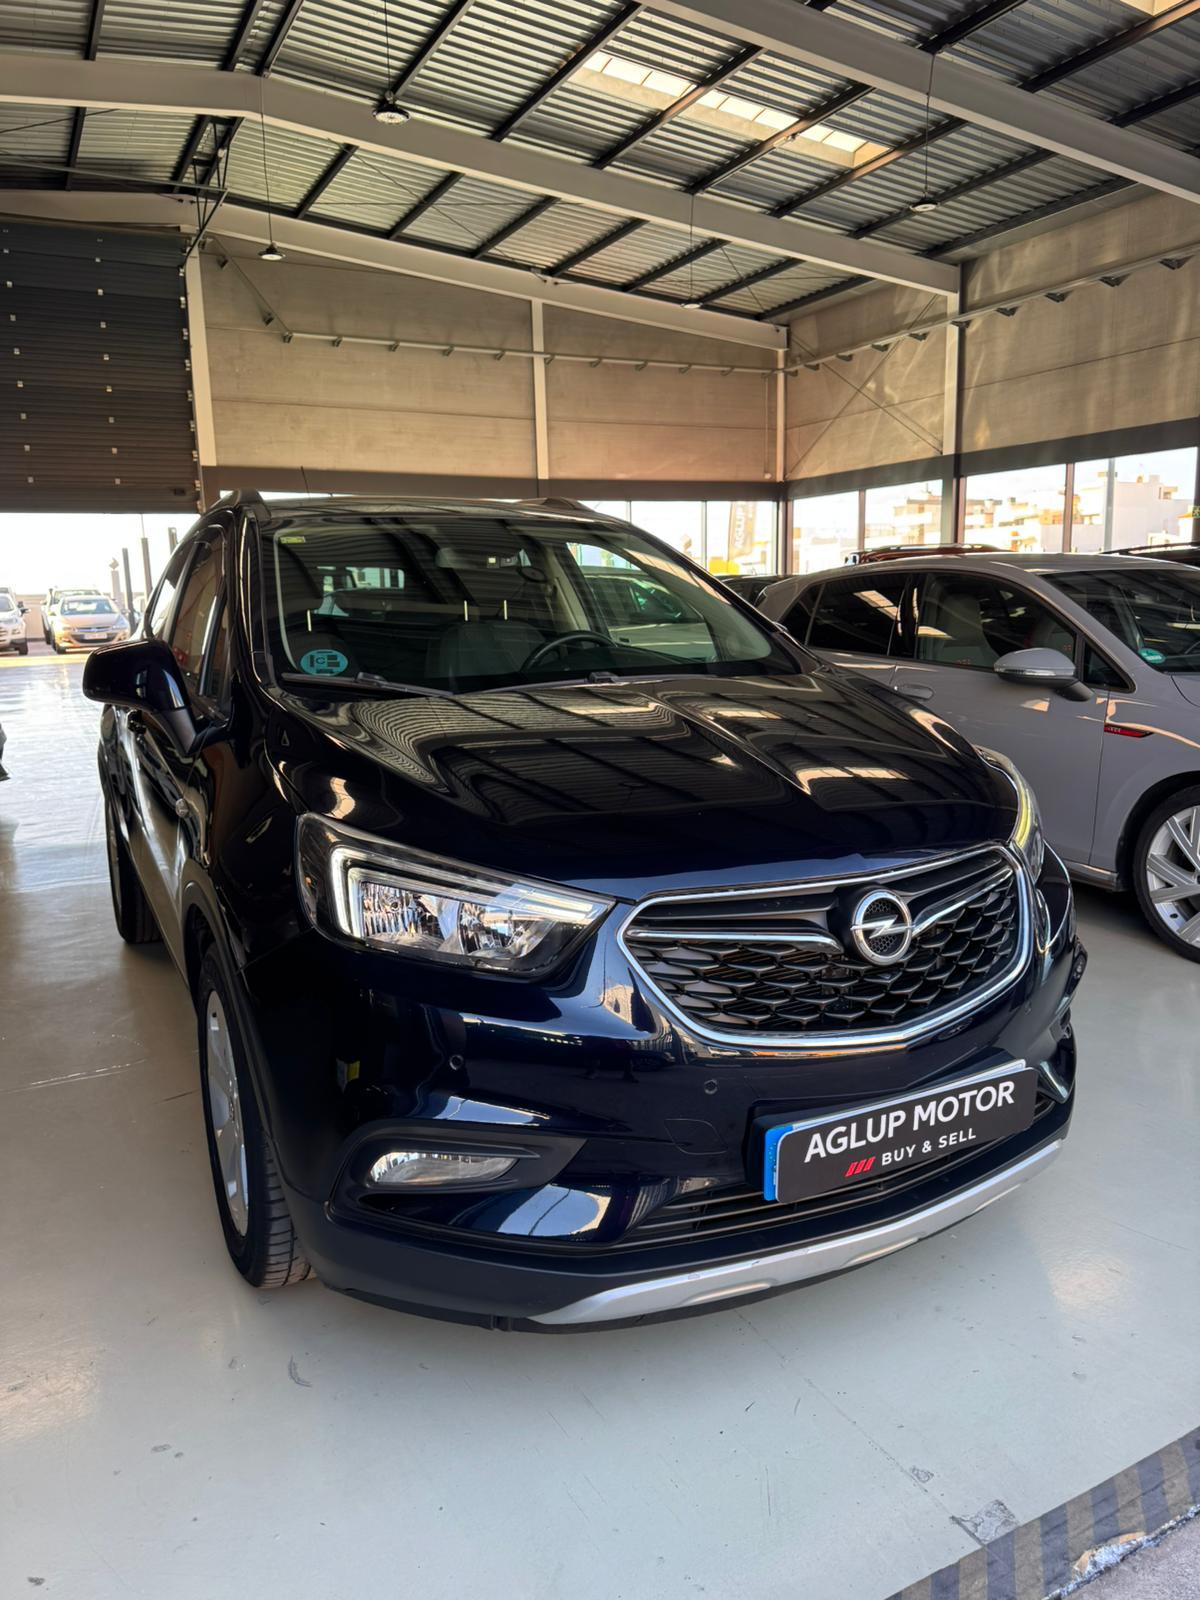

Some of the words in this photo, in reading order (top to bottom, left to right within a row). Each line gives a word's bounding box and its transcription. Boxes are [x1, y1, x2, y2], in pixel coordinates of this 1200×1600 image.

[804, 1109, 907, 1164] AGLUP
[912, 1080, 1016, 1131] MOTOR
[881, 1143, 917, 1166] BUY
[921, 1140, 932, 1154] &
[938, 1127, 977, 1149] SELL
